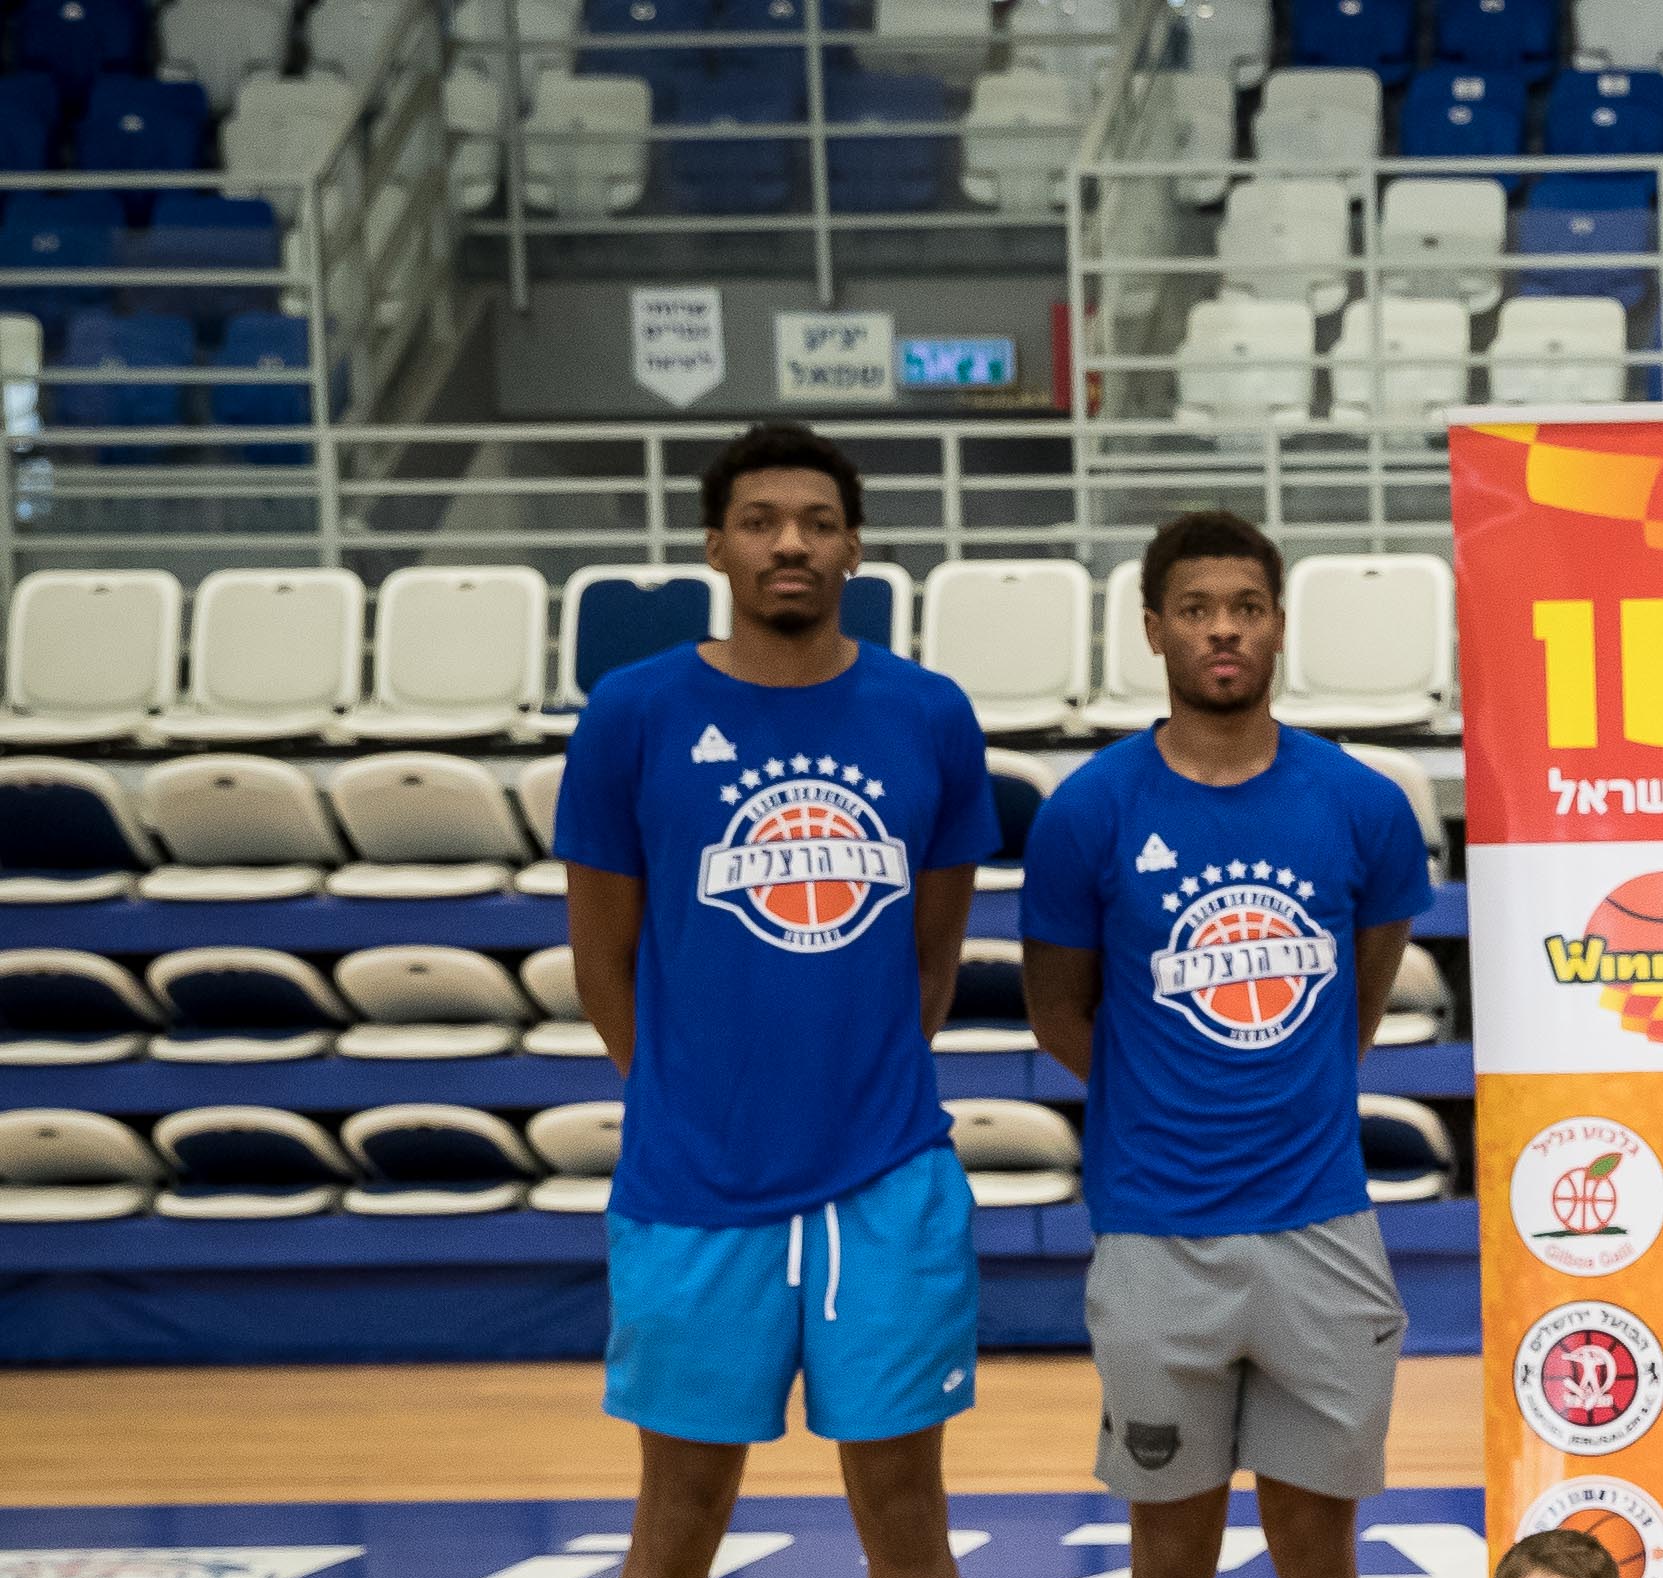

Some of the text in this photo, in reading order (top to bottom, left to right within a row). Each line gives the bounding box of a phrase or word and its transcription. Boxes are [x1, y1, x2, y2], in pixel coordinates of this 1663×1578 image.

[728, 845, 889, 886] בני הרצליה
[1173, 943, 1320, 989] בני הרצליה
